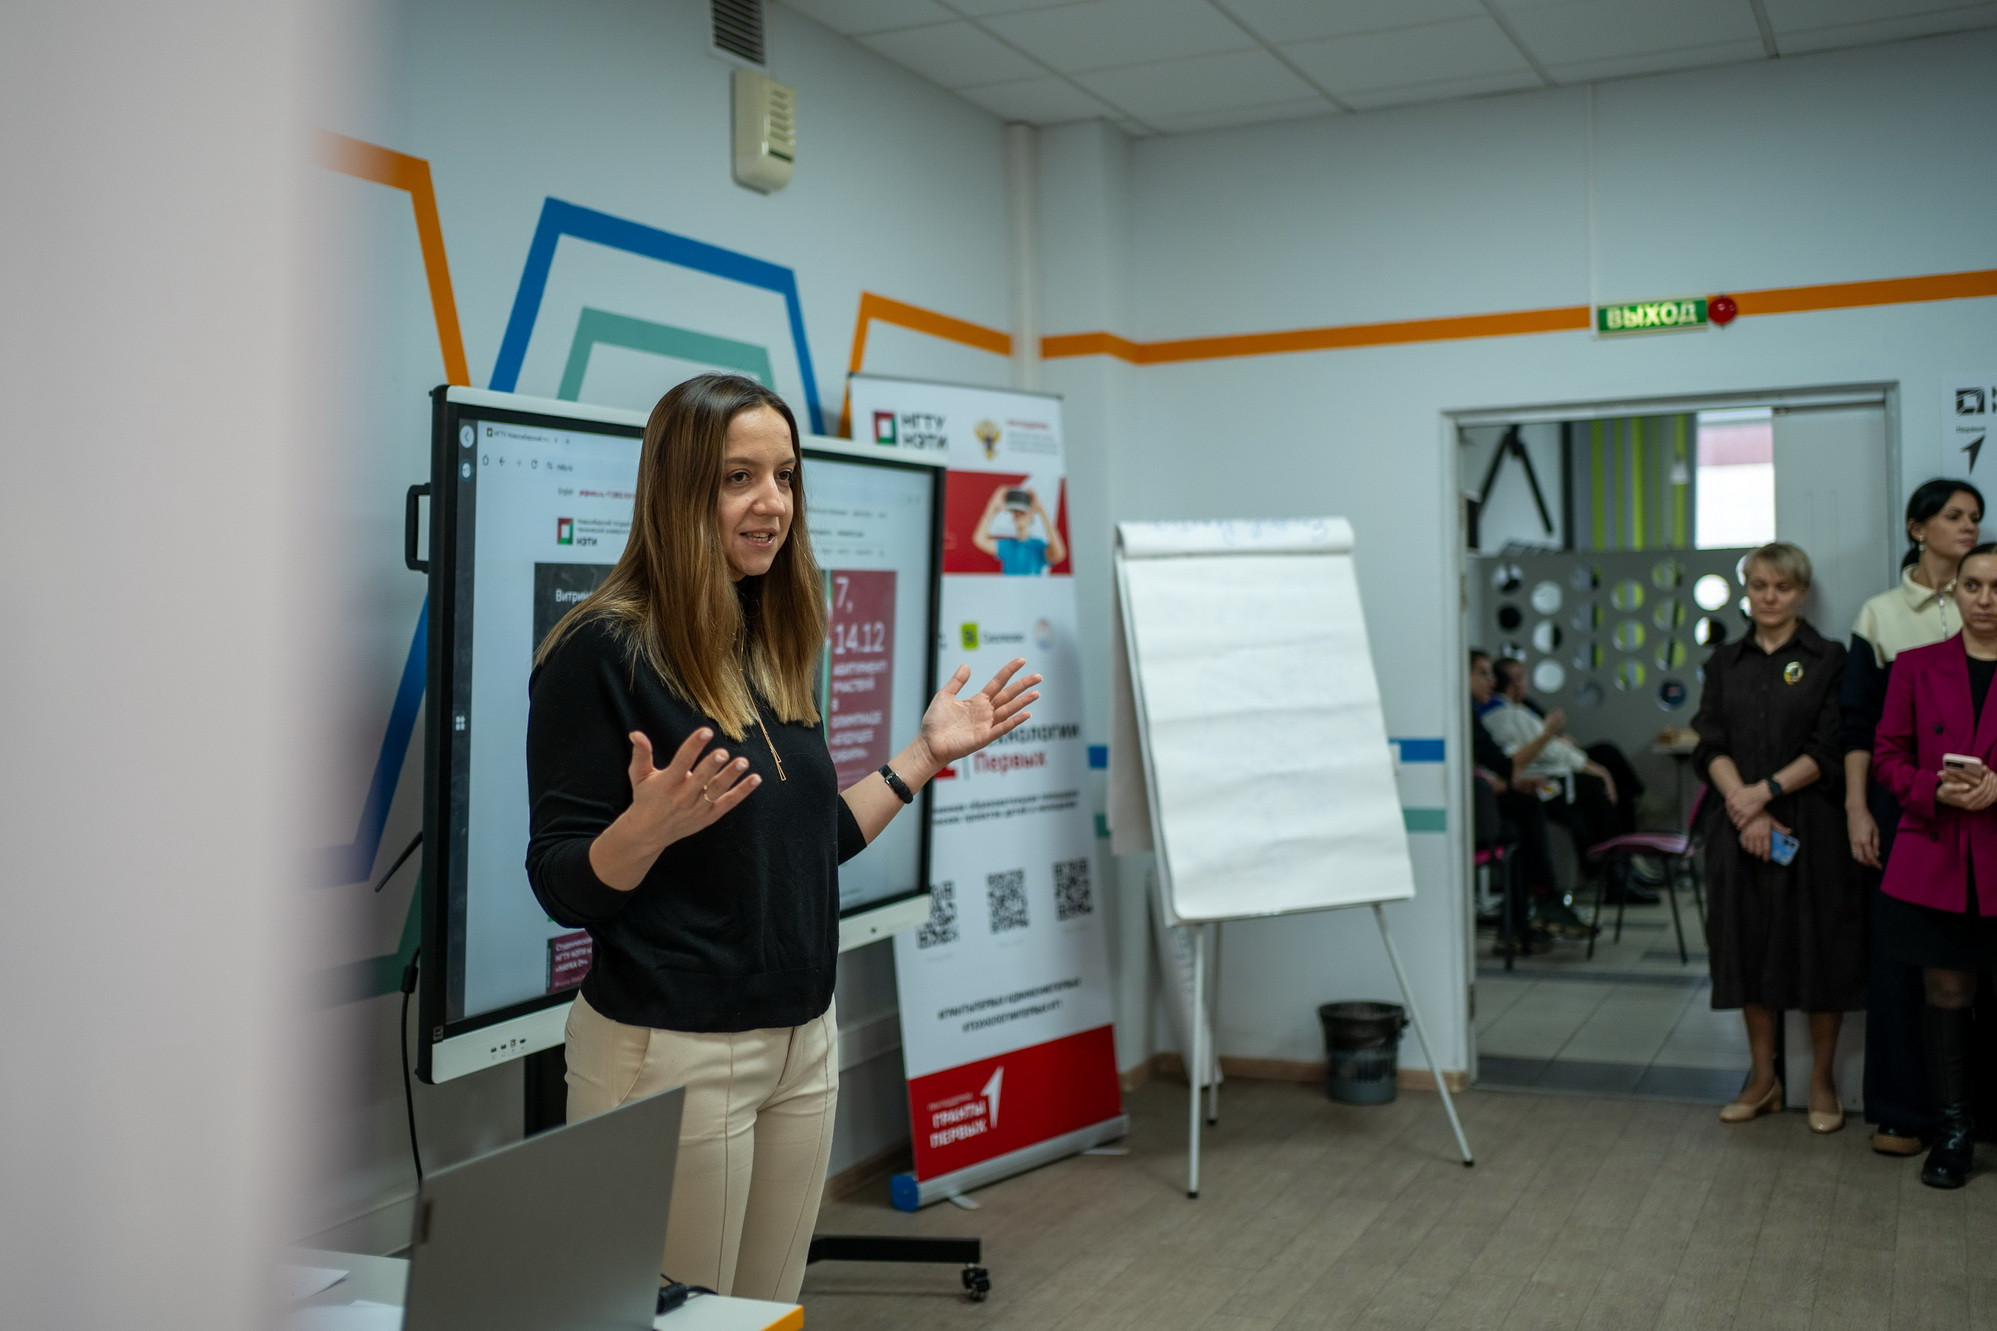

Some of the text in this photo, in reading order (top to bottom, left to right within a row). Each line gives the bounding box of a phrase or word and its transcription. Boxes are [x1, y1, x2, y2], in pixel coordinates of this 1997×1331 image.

[1606, 301, 1697, 329] ВЫХОД
[900, 412, 946, 431] НГТУ
[901, 432, 948, 451] НЭТИ
[576, 537, 597, 547] НЭТИ
[556, 588, 593, 605] Витрин
[835, 577, 854, 614] 7,
[833, 621, 886, 655] 14.12
[973, 751, 1046, 776] Первых
[555, 937, 593, 952] Студенческ
[932, 1099, 987, 1129] ГРАНТЫ
[929, 1117, 988, 1149] ПЕРВЫХ
